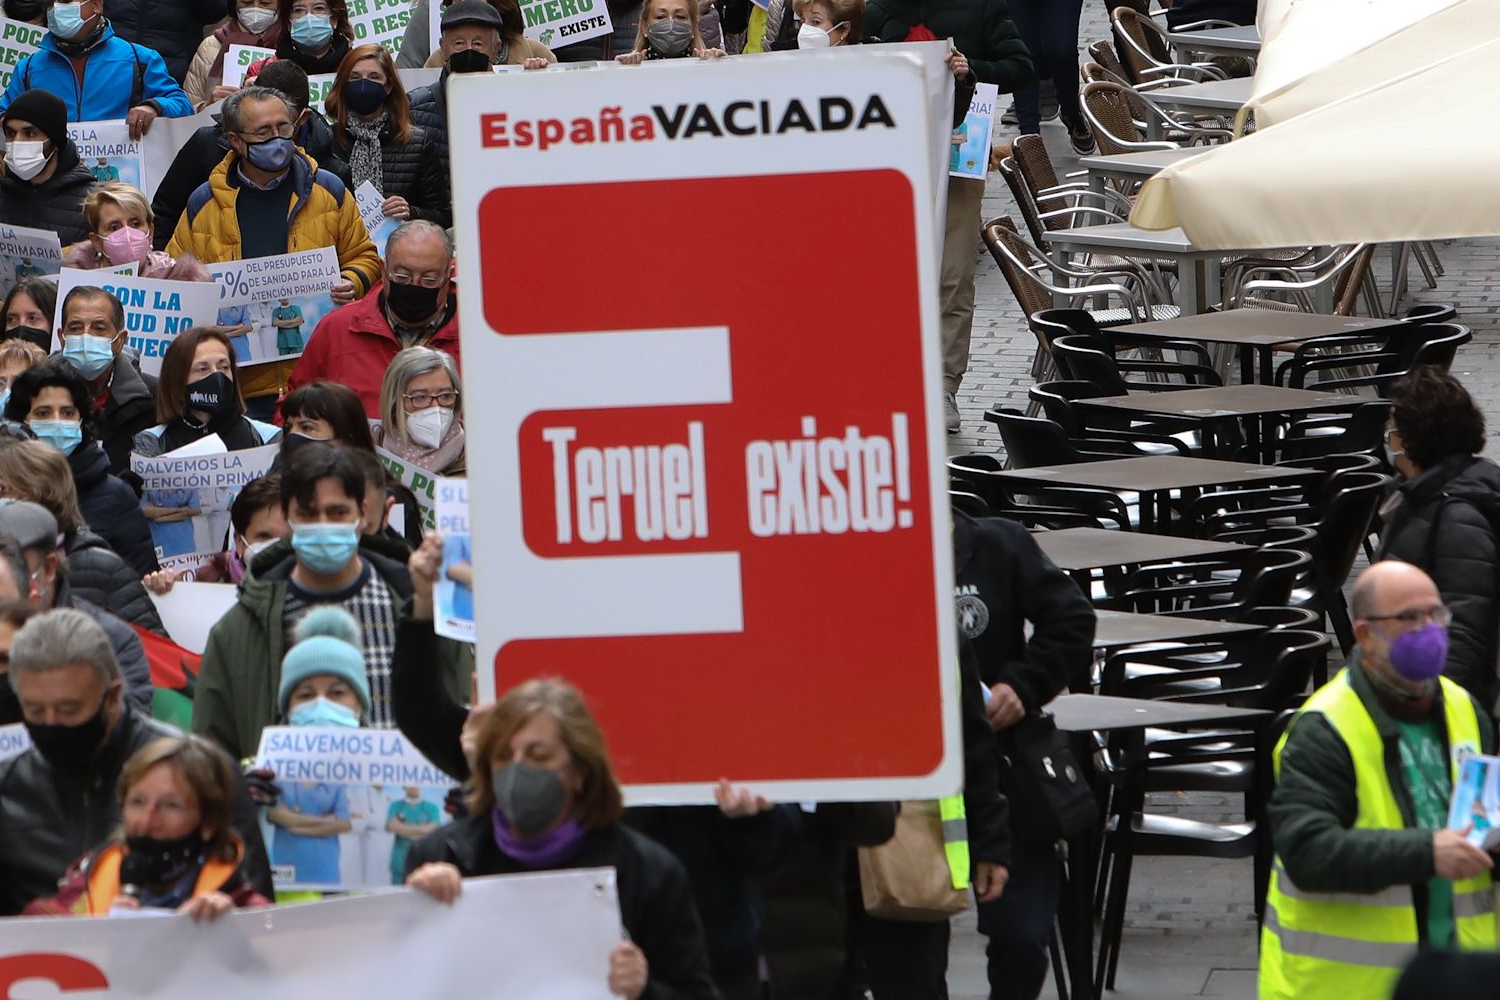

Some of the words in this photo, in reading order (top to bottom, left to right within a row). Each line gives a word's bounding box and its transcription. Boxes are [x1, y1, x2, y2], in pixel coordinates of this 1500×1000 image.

[560, 15, 606, 38] EXISTE
[481, 95, 896, 151] EspañaVACIADA
[82, 129, 98, 141] LA
[247, 261, 263, 273] DEL
[264, 253, 324, 271] PRESUPUESTO
[249, 277, 261, 288] DE
[263, 271, 300, 287] SANIDAD
[302, 268, 322, 281] PARA
[325, 266, 337, 278] LA
[153, 290, 181, 311] LA
[223, 455, 243, 470] LA
[543, 420, 708, 545] Teruel
[745, 412, 914, 538] existe!
[263, 734, 374, 754] ¡SALVEMOS
[380, 736, 404, 757] LA
